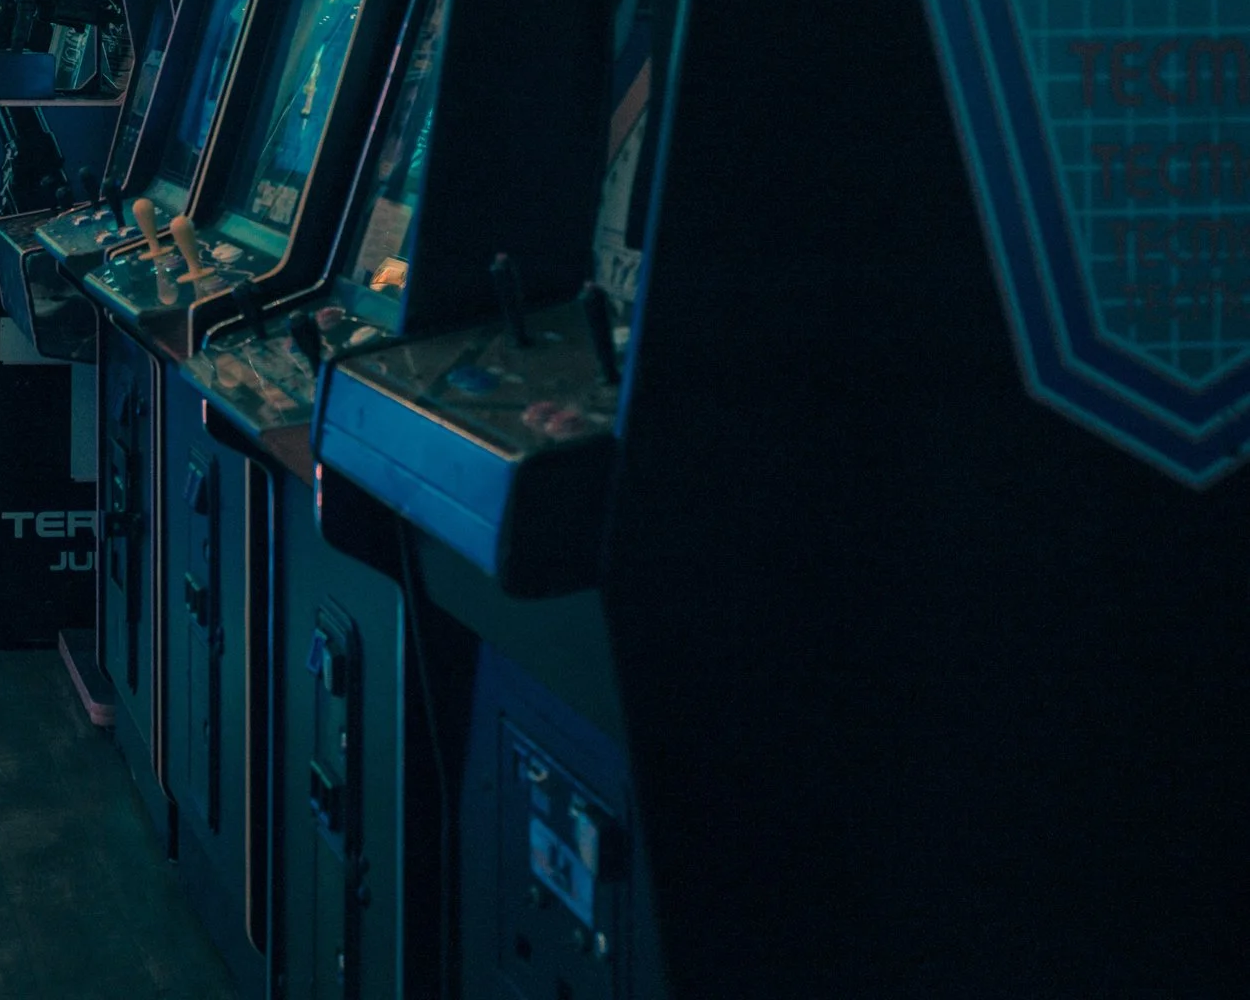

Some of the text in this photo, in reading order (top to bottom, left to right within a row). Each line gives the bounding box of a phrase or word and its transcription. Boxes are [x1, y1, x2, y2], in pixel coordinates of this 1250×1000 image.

[1091, 142, 1250, 200] TECM
[1, 510, 98, 539] TER
[50, 551, 97, 571] JU
